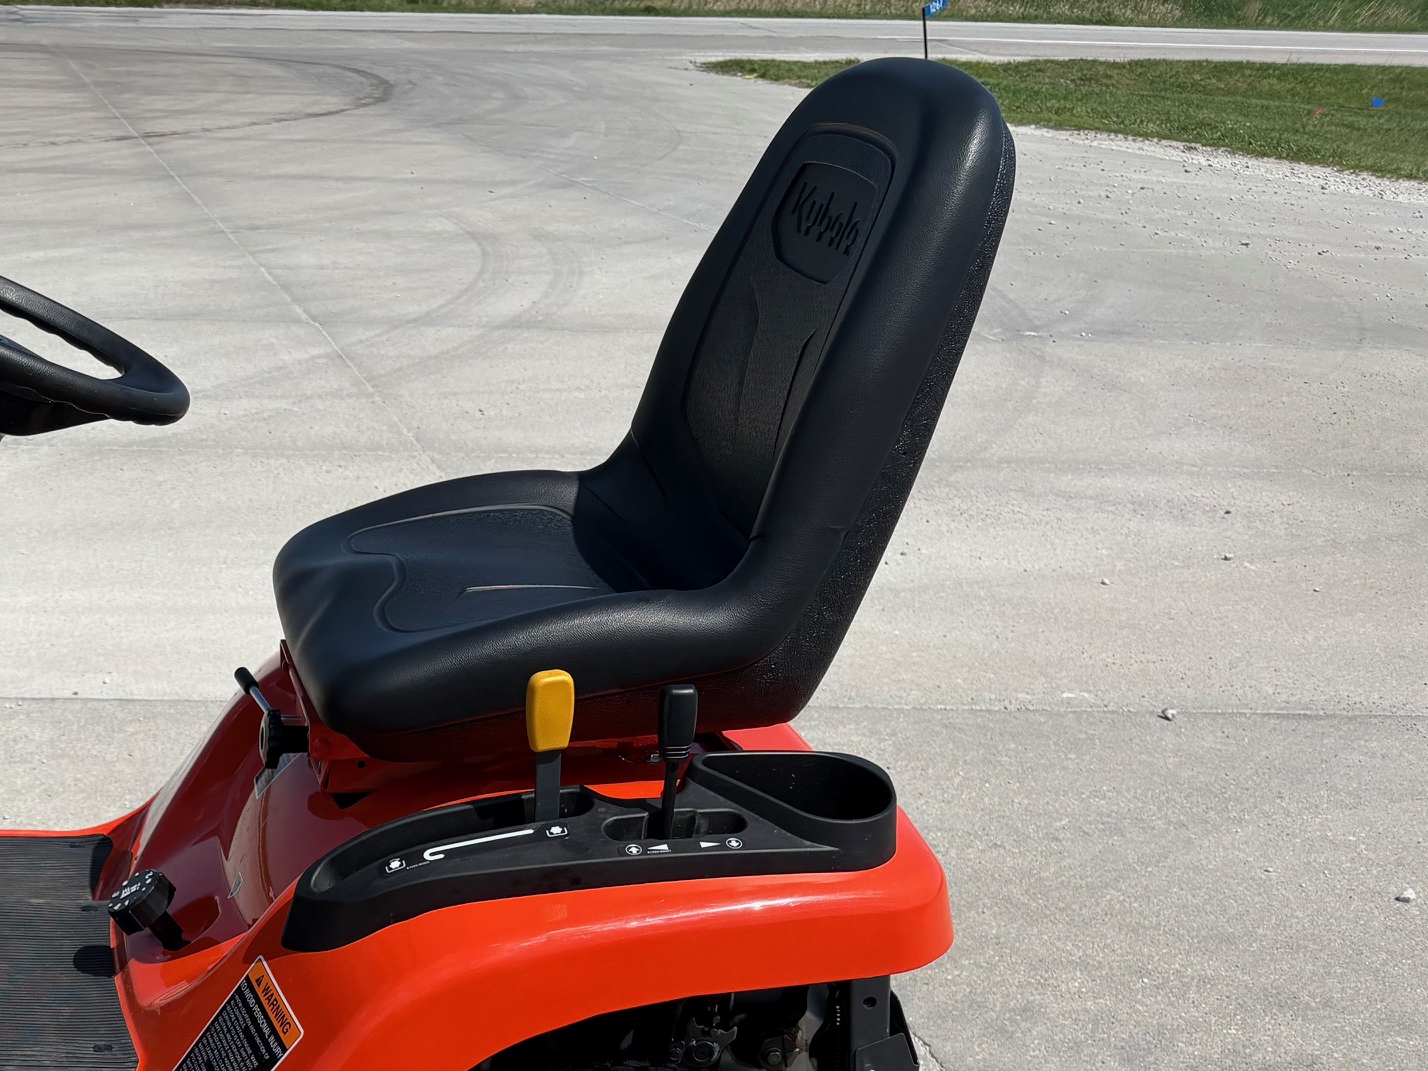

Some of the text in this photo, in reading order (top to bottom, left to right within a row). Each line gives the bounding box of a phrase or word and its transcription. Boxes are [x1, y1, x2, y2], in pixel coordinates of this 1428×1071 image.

[791, 182, 861, 257] Kubota
[243, 986, 256, 1008] AVOID
[251, 1003, 272, 1039] PERSONAL
[267, 1033, 283, 1060] INJURY
[260, 982, 292, 1036] WARNING
